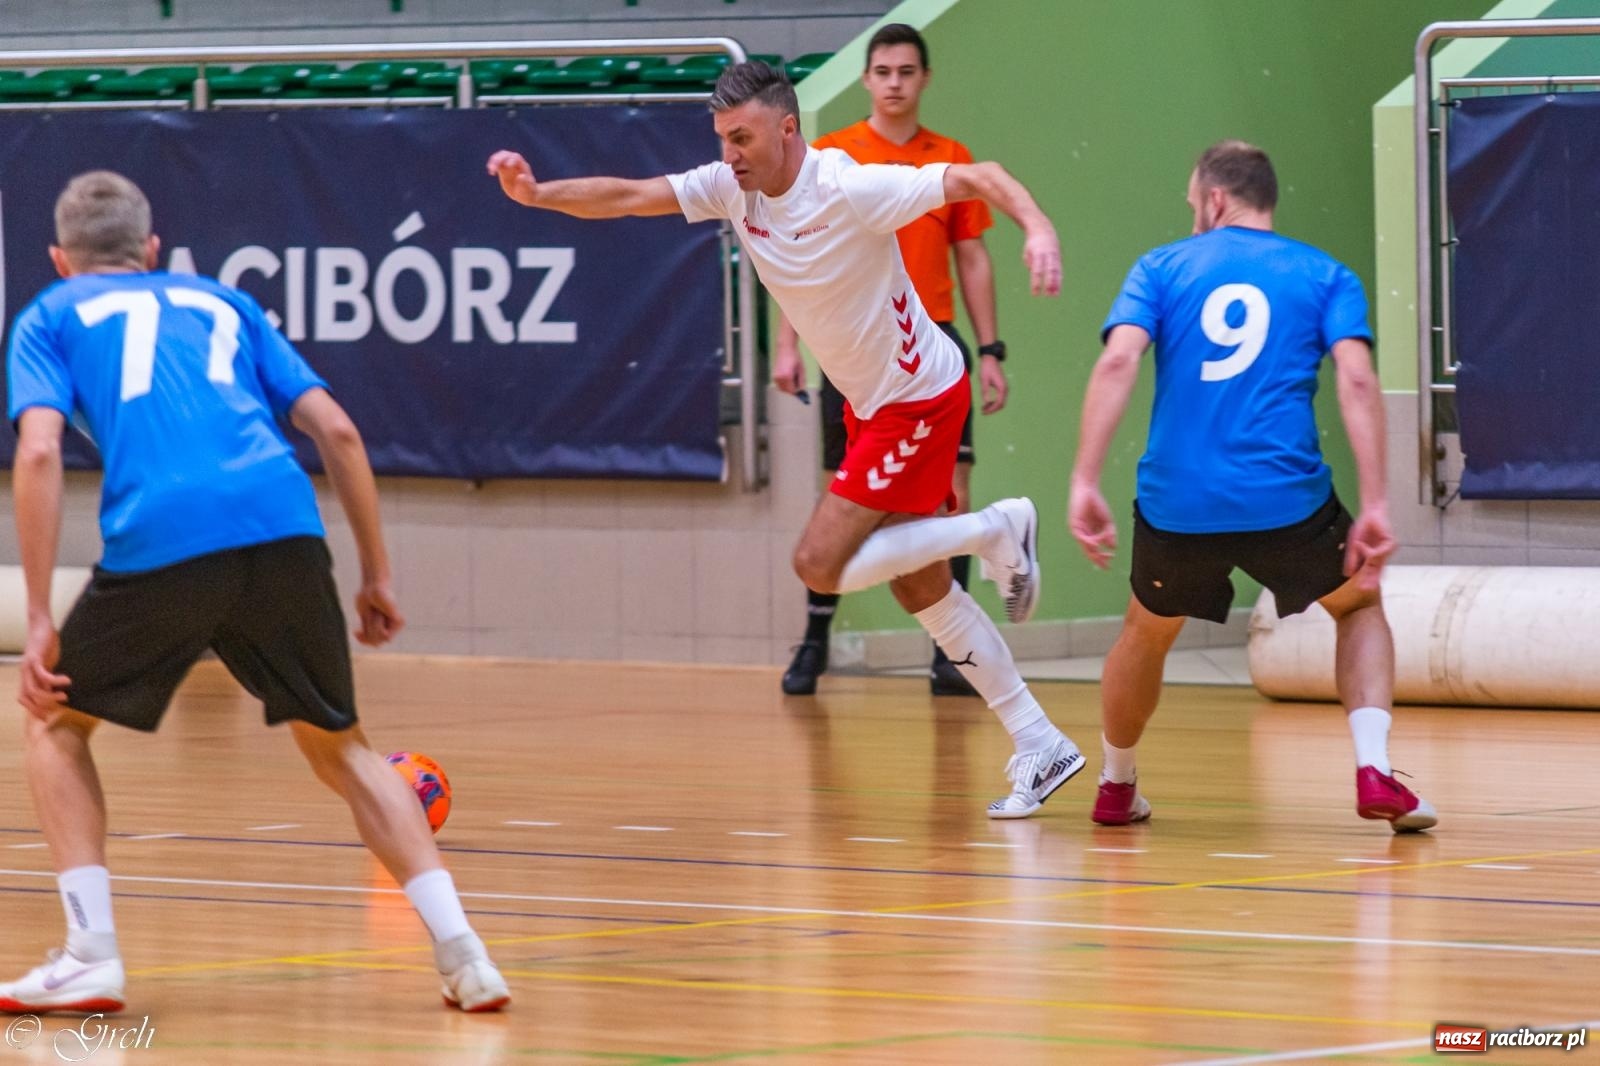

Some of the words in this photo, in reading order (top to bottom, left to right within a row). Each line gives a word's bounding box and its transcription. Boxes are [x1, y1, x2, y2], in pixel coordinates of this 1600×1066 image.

[167, 211, 577, 344] CIBÓRZ
[1200, 283, 1270, 382] 9
[75, 287, 241, 403] 77
